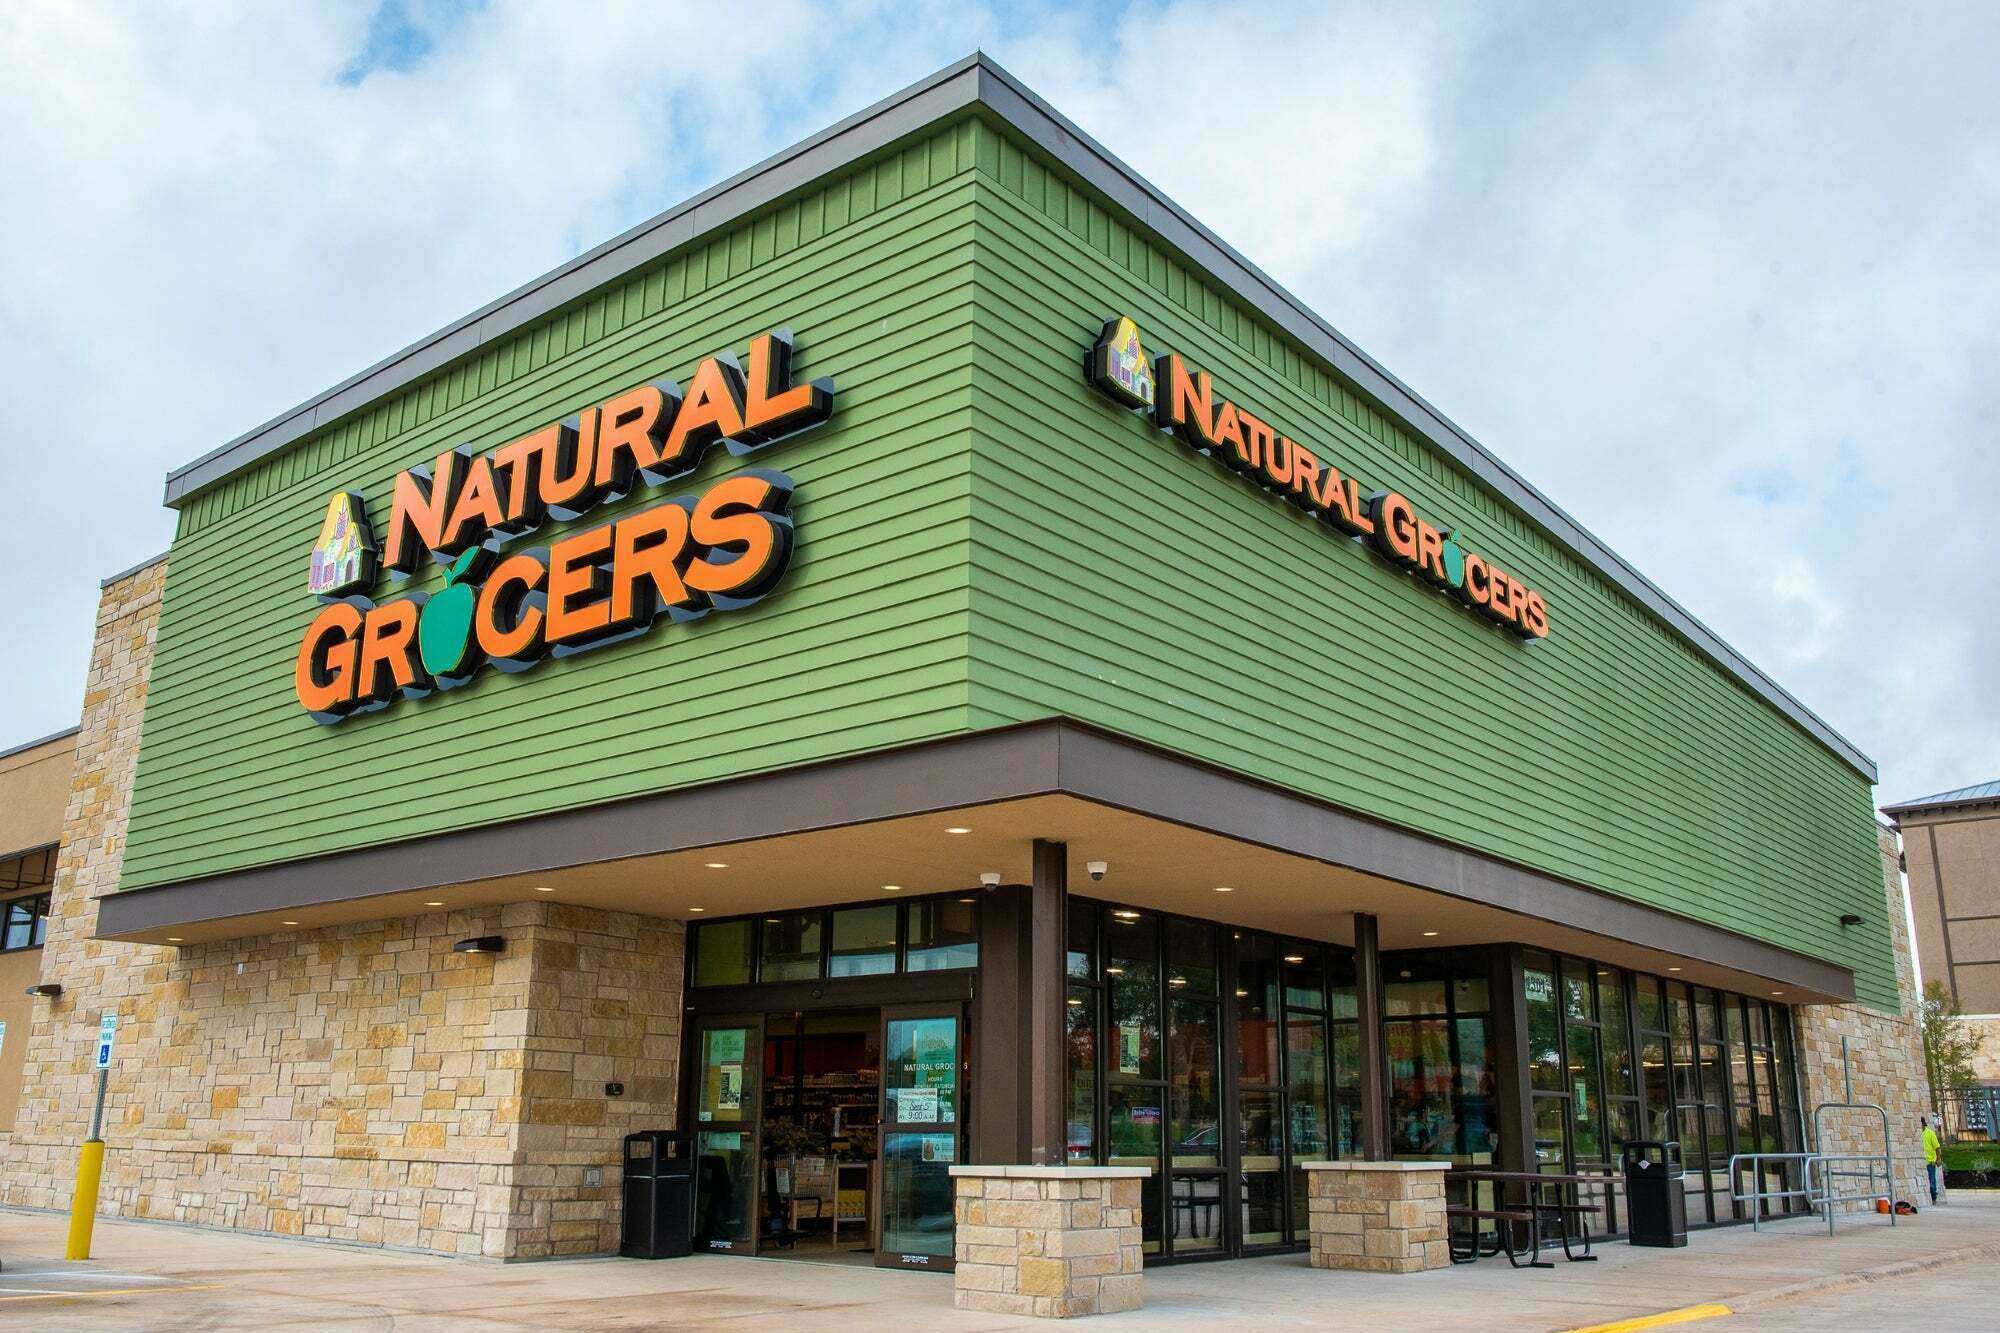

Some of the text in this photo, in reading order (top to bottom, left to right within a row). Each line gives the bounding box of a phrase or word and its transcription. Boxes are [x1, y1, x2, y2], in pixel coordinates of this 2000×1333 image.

[382, 331, 814, 570] NATURAL
[1171, 353, 1550, 639] NATURAL GROCERS
[295, 475, 778, 712] GROCERS
[904, 1064, 934, 1072] NATURAL
